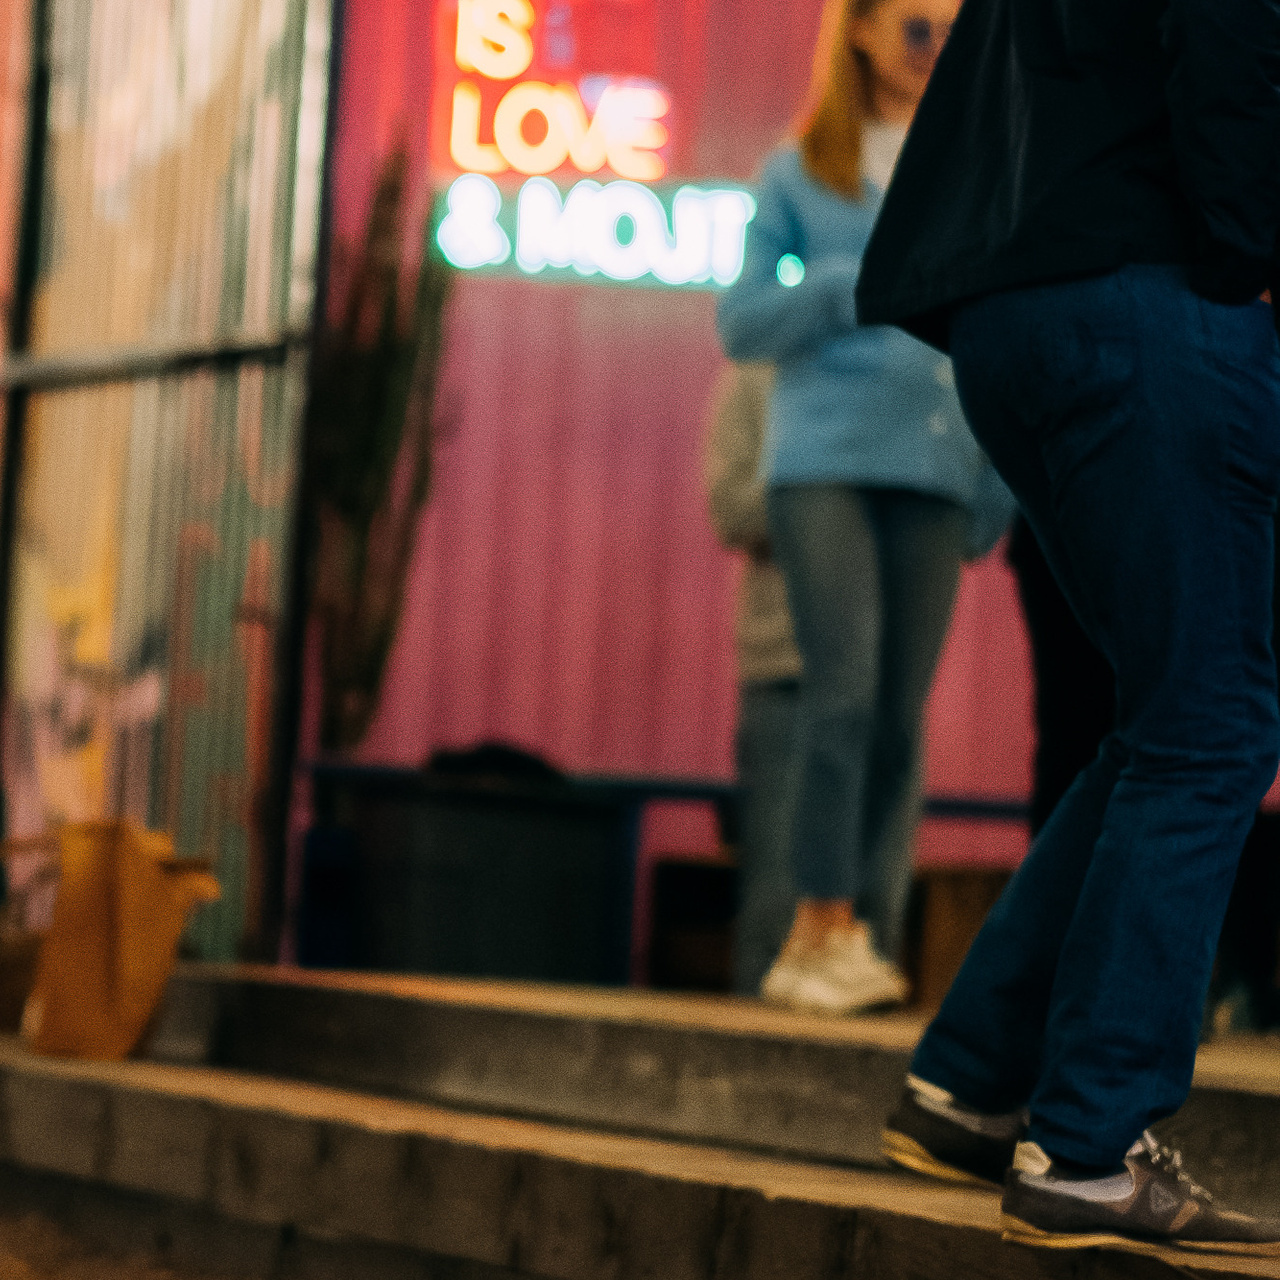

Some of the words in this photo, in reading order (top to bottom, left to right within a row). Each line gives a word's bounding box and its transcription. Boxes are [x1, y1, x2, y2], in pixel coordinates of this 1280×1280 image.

[449, 81, 669, 181] LOVE
[437, 173, 510, 269] &
[517, 176, 757, 287] MOJIT
